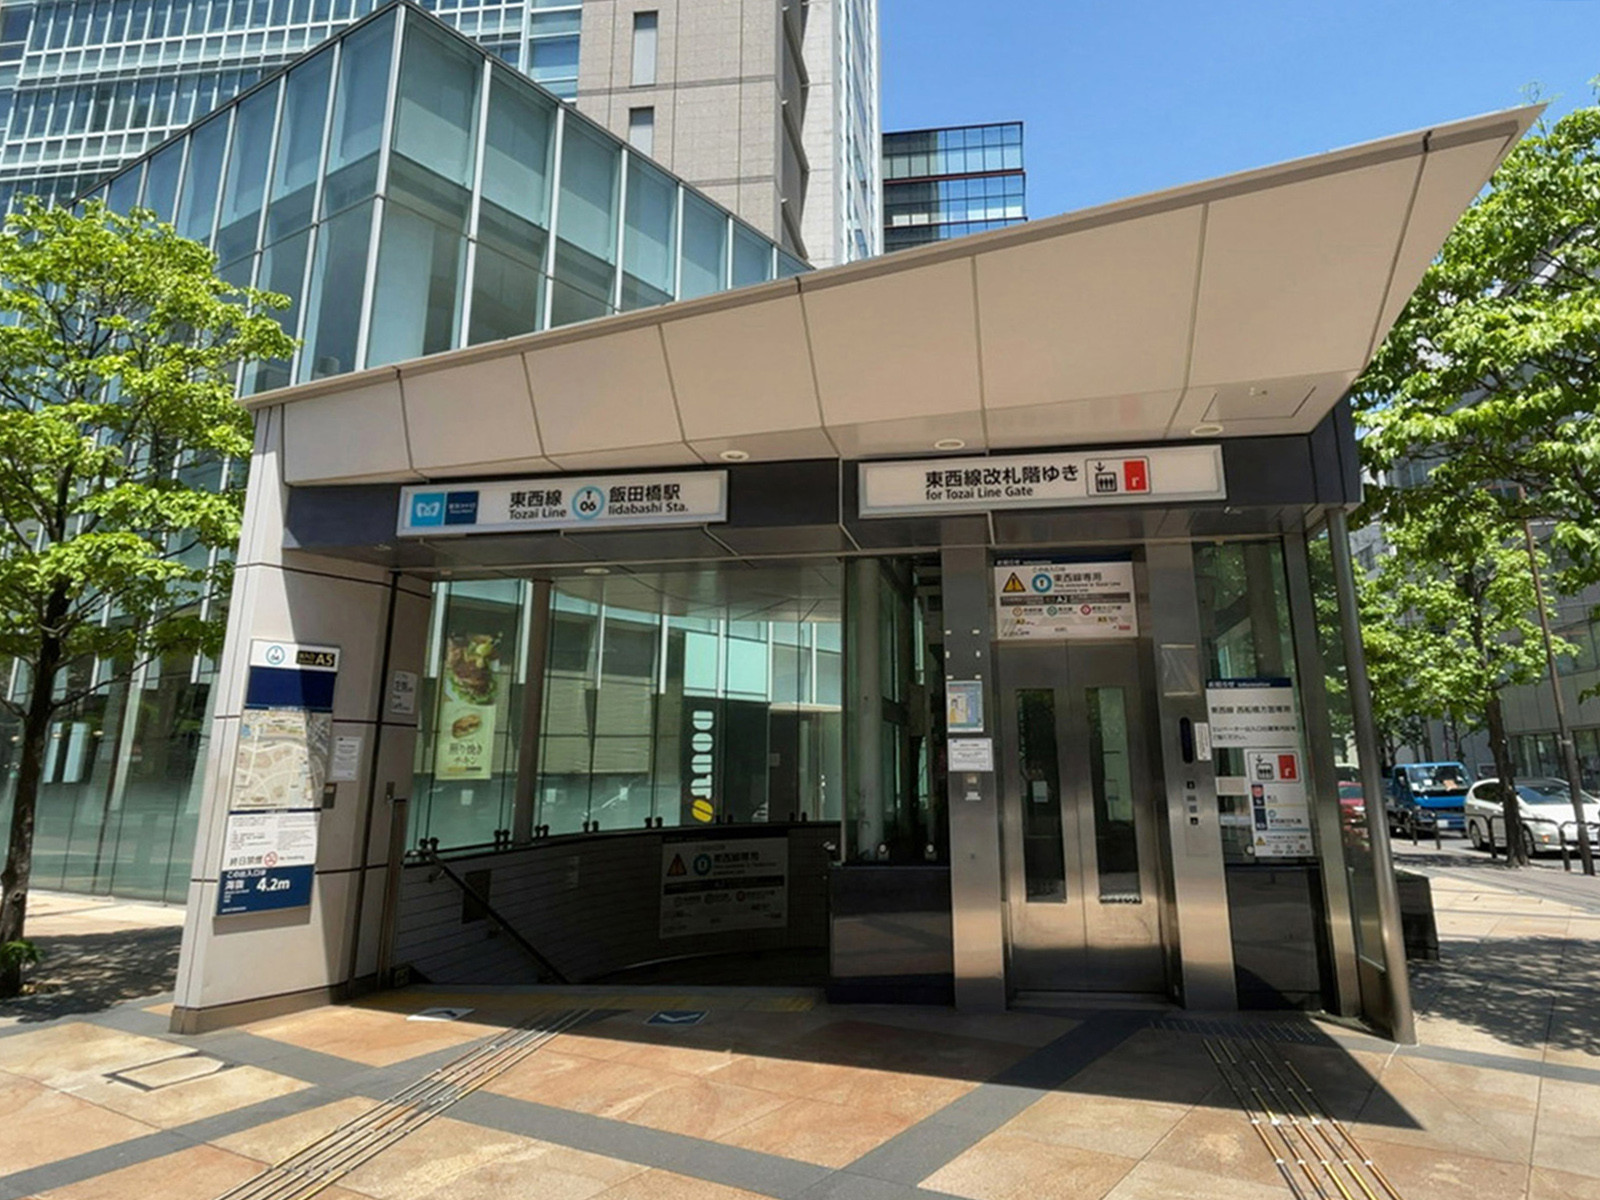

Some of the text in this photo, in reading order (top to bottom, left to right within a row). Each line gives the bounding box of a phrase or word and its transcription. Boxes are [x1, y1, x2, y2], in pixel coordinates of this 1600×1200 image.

[925, 464, 1078, 488] 東西線改札階ゆき
[510, 489, 562, 508] 東西線
[609, 484, 680, 503] 飯田橋駅
[926, 486, 1033, 500] for Tozai Line Gate
[509, 507, 567, 519] Tozai Line
[580, 501, 597, 511] 06
[608, 501, 689, 515] Iidabashi Sta.
[315, 653, 334, 666] A5
[256, 877, 291, 892] 4.2m
